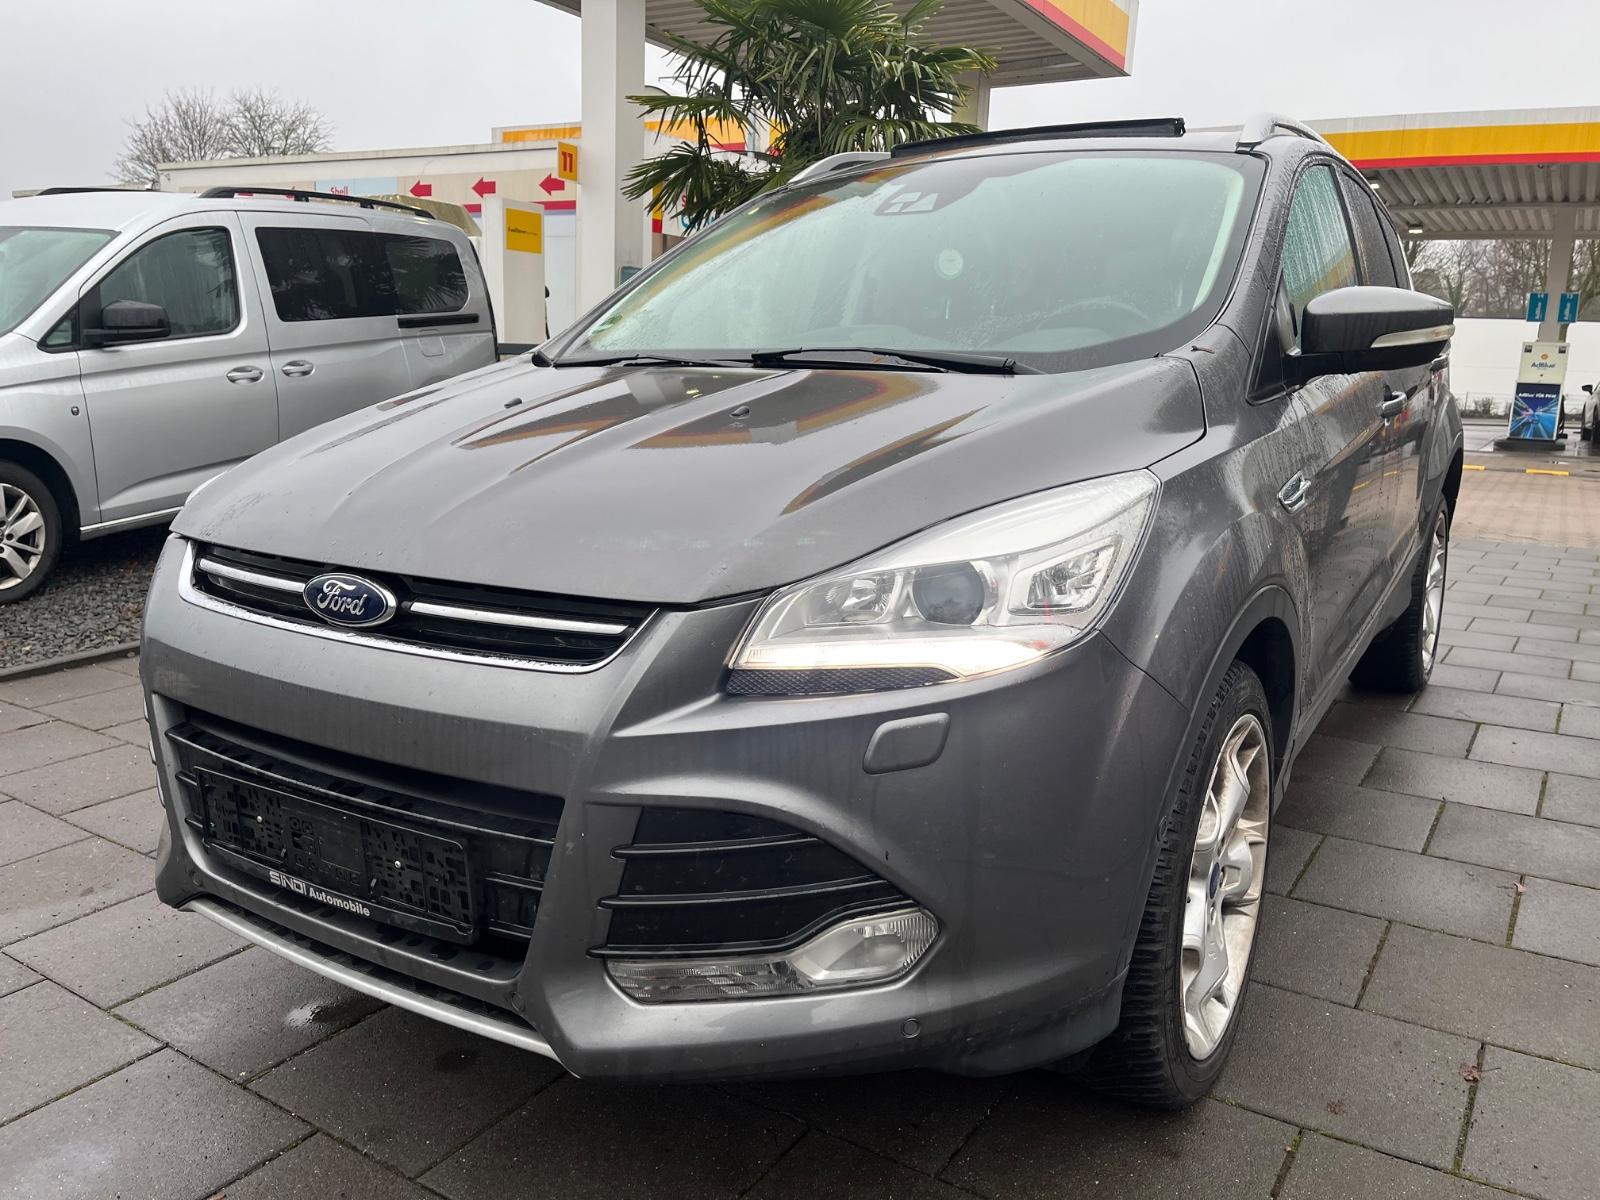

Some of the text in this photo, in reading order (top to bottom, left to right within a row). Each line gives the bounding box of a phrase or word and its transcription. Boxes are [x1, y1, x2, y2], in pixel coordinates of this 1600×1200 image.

[561, 151, 574, 173] 11
[330, 186, 348, 196] Shell
[316, 579, 368, 616] Ford
[269, 870, 371, 917] SINDI Automobile
